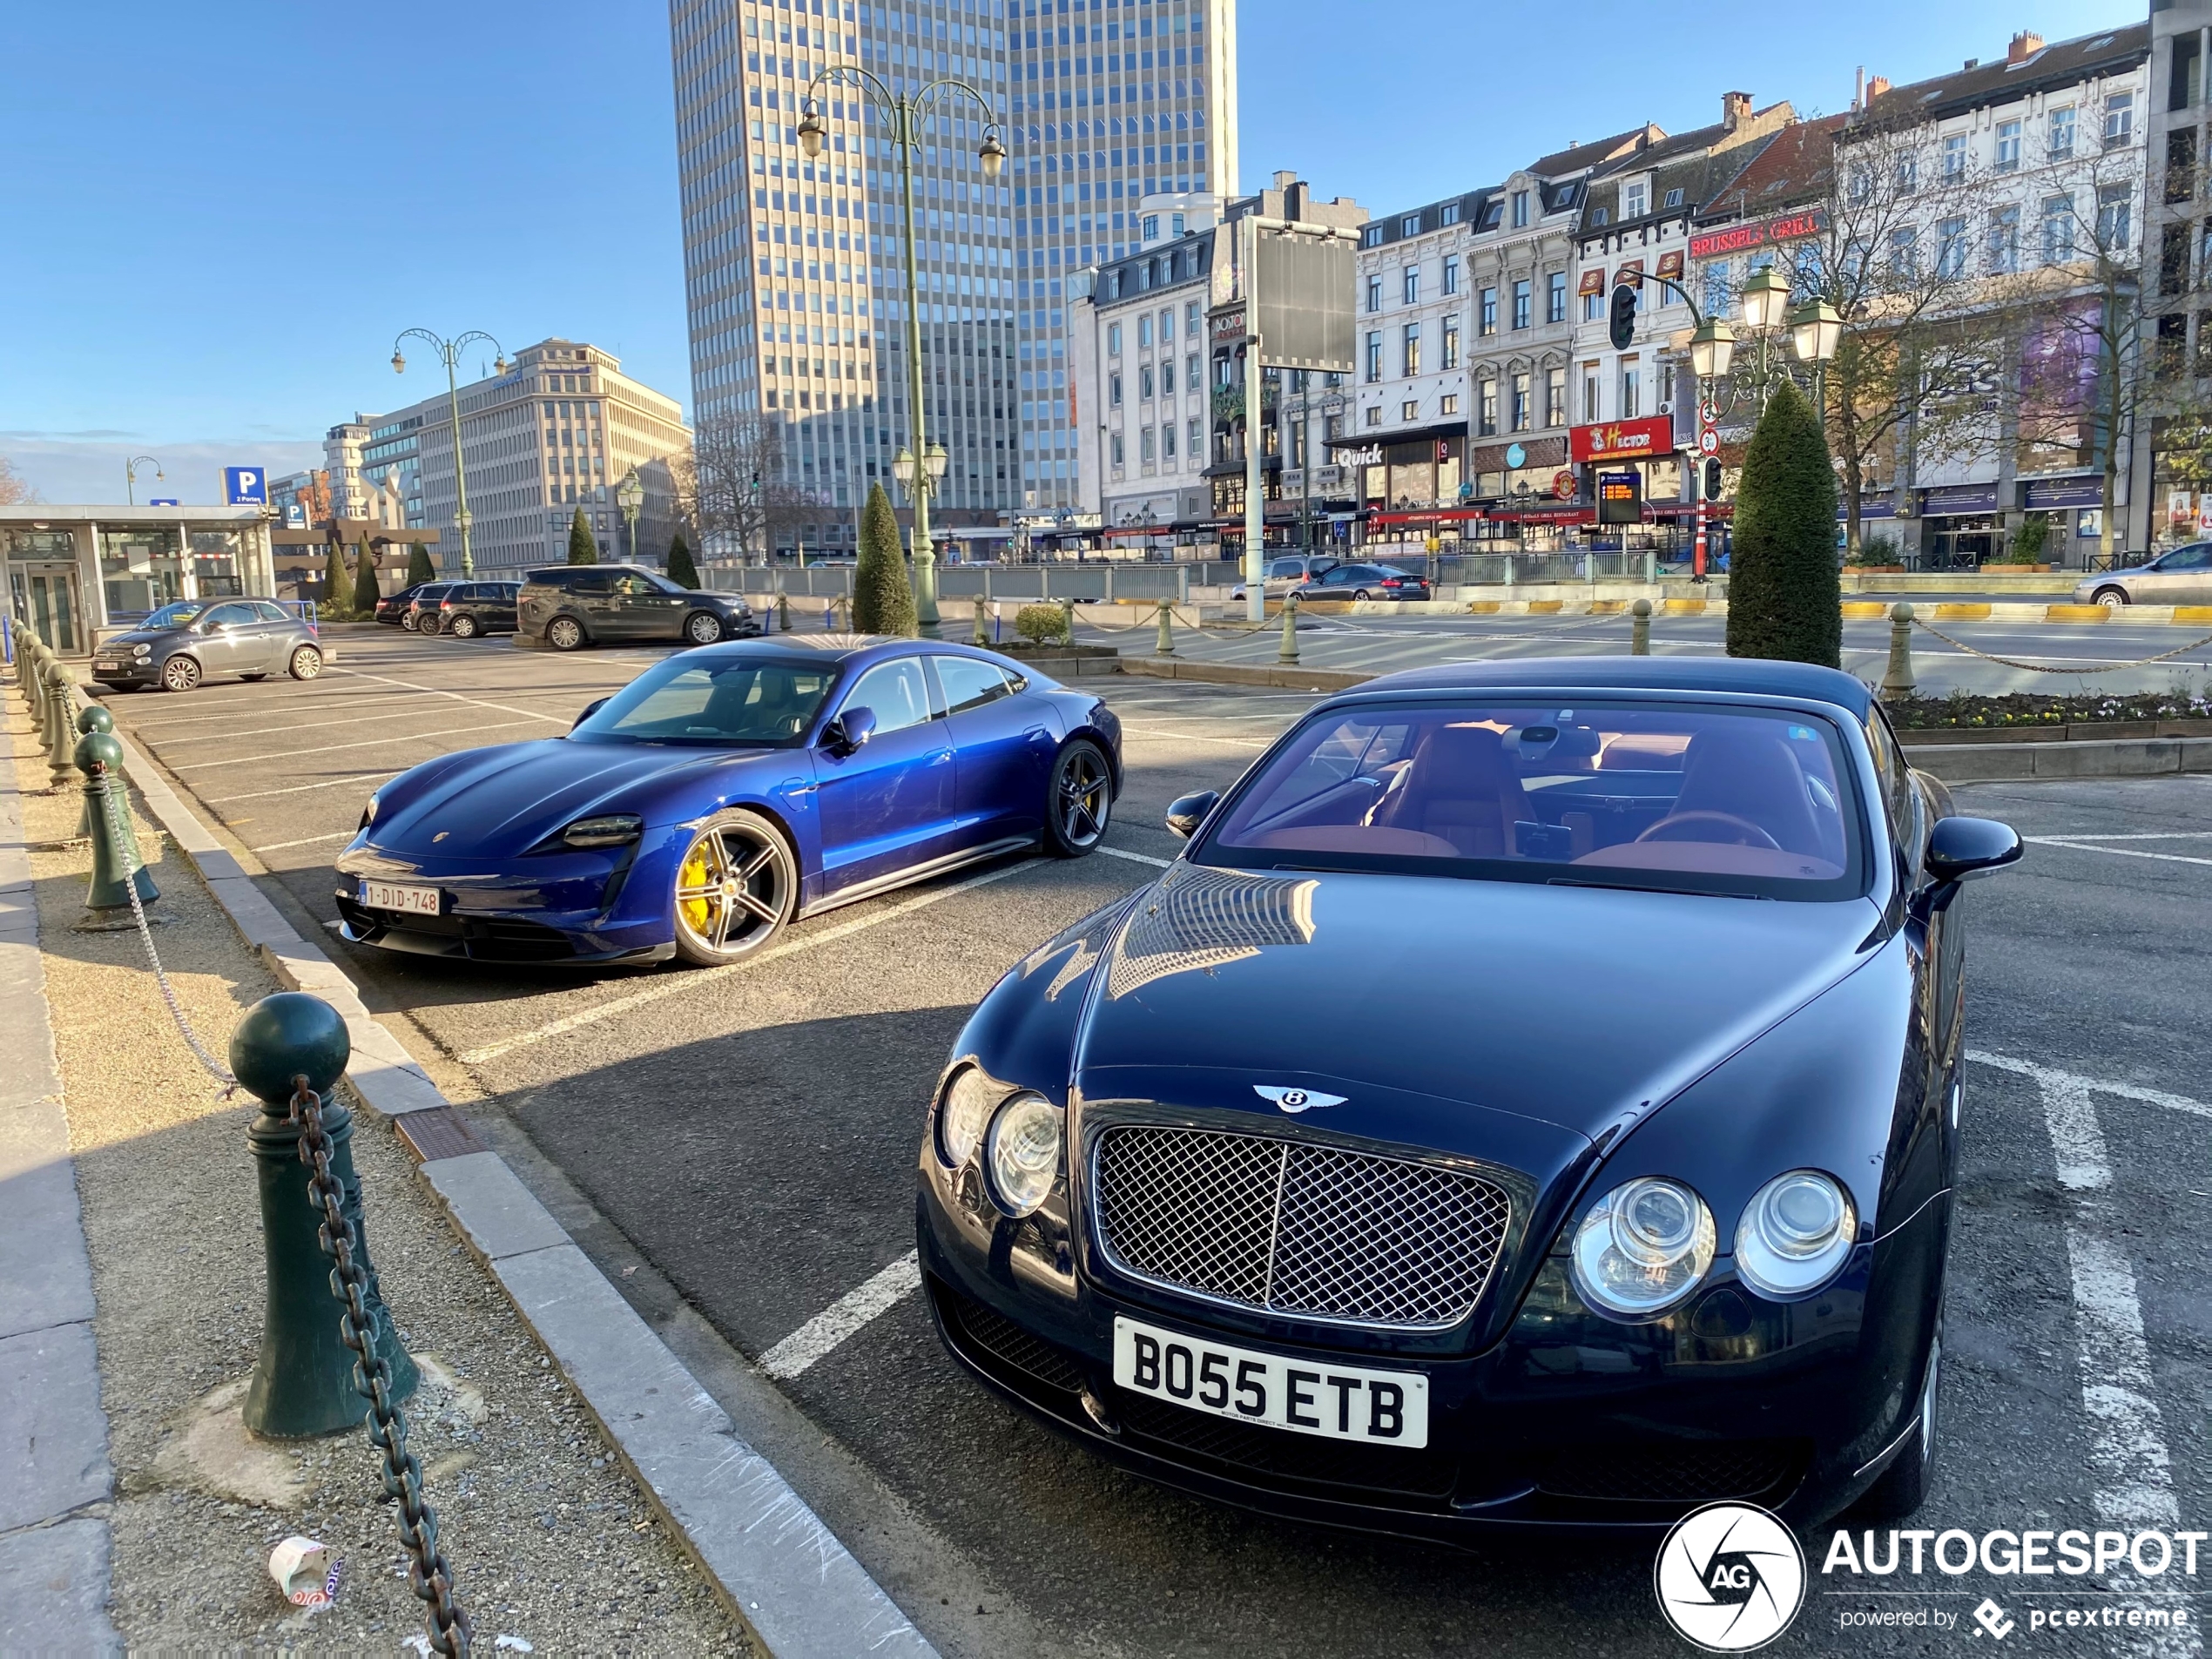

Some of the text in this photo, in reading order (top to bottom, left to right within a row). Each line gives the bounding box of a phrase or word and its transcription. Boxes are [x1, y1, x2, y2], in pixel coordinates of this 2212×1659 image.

[1690, 215, 1819, 257] BRUSSELS GRILL
[1676, 432, 1692, 442] UGC
[1339, 442, 1383, 469] Quick
[239, 471, 257, 494] P
[289, 505, 300, 518] P
[368, 887, 437, 911] 1-DID-748
[1285, 1091, 1304, 1104] B
[1221, 1410, 1238, 1419] MOTOR
[1286, 1368, 1404, 1439] ETB
